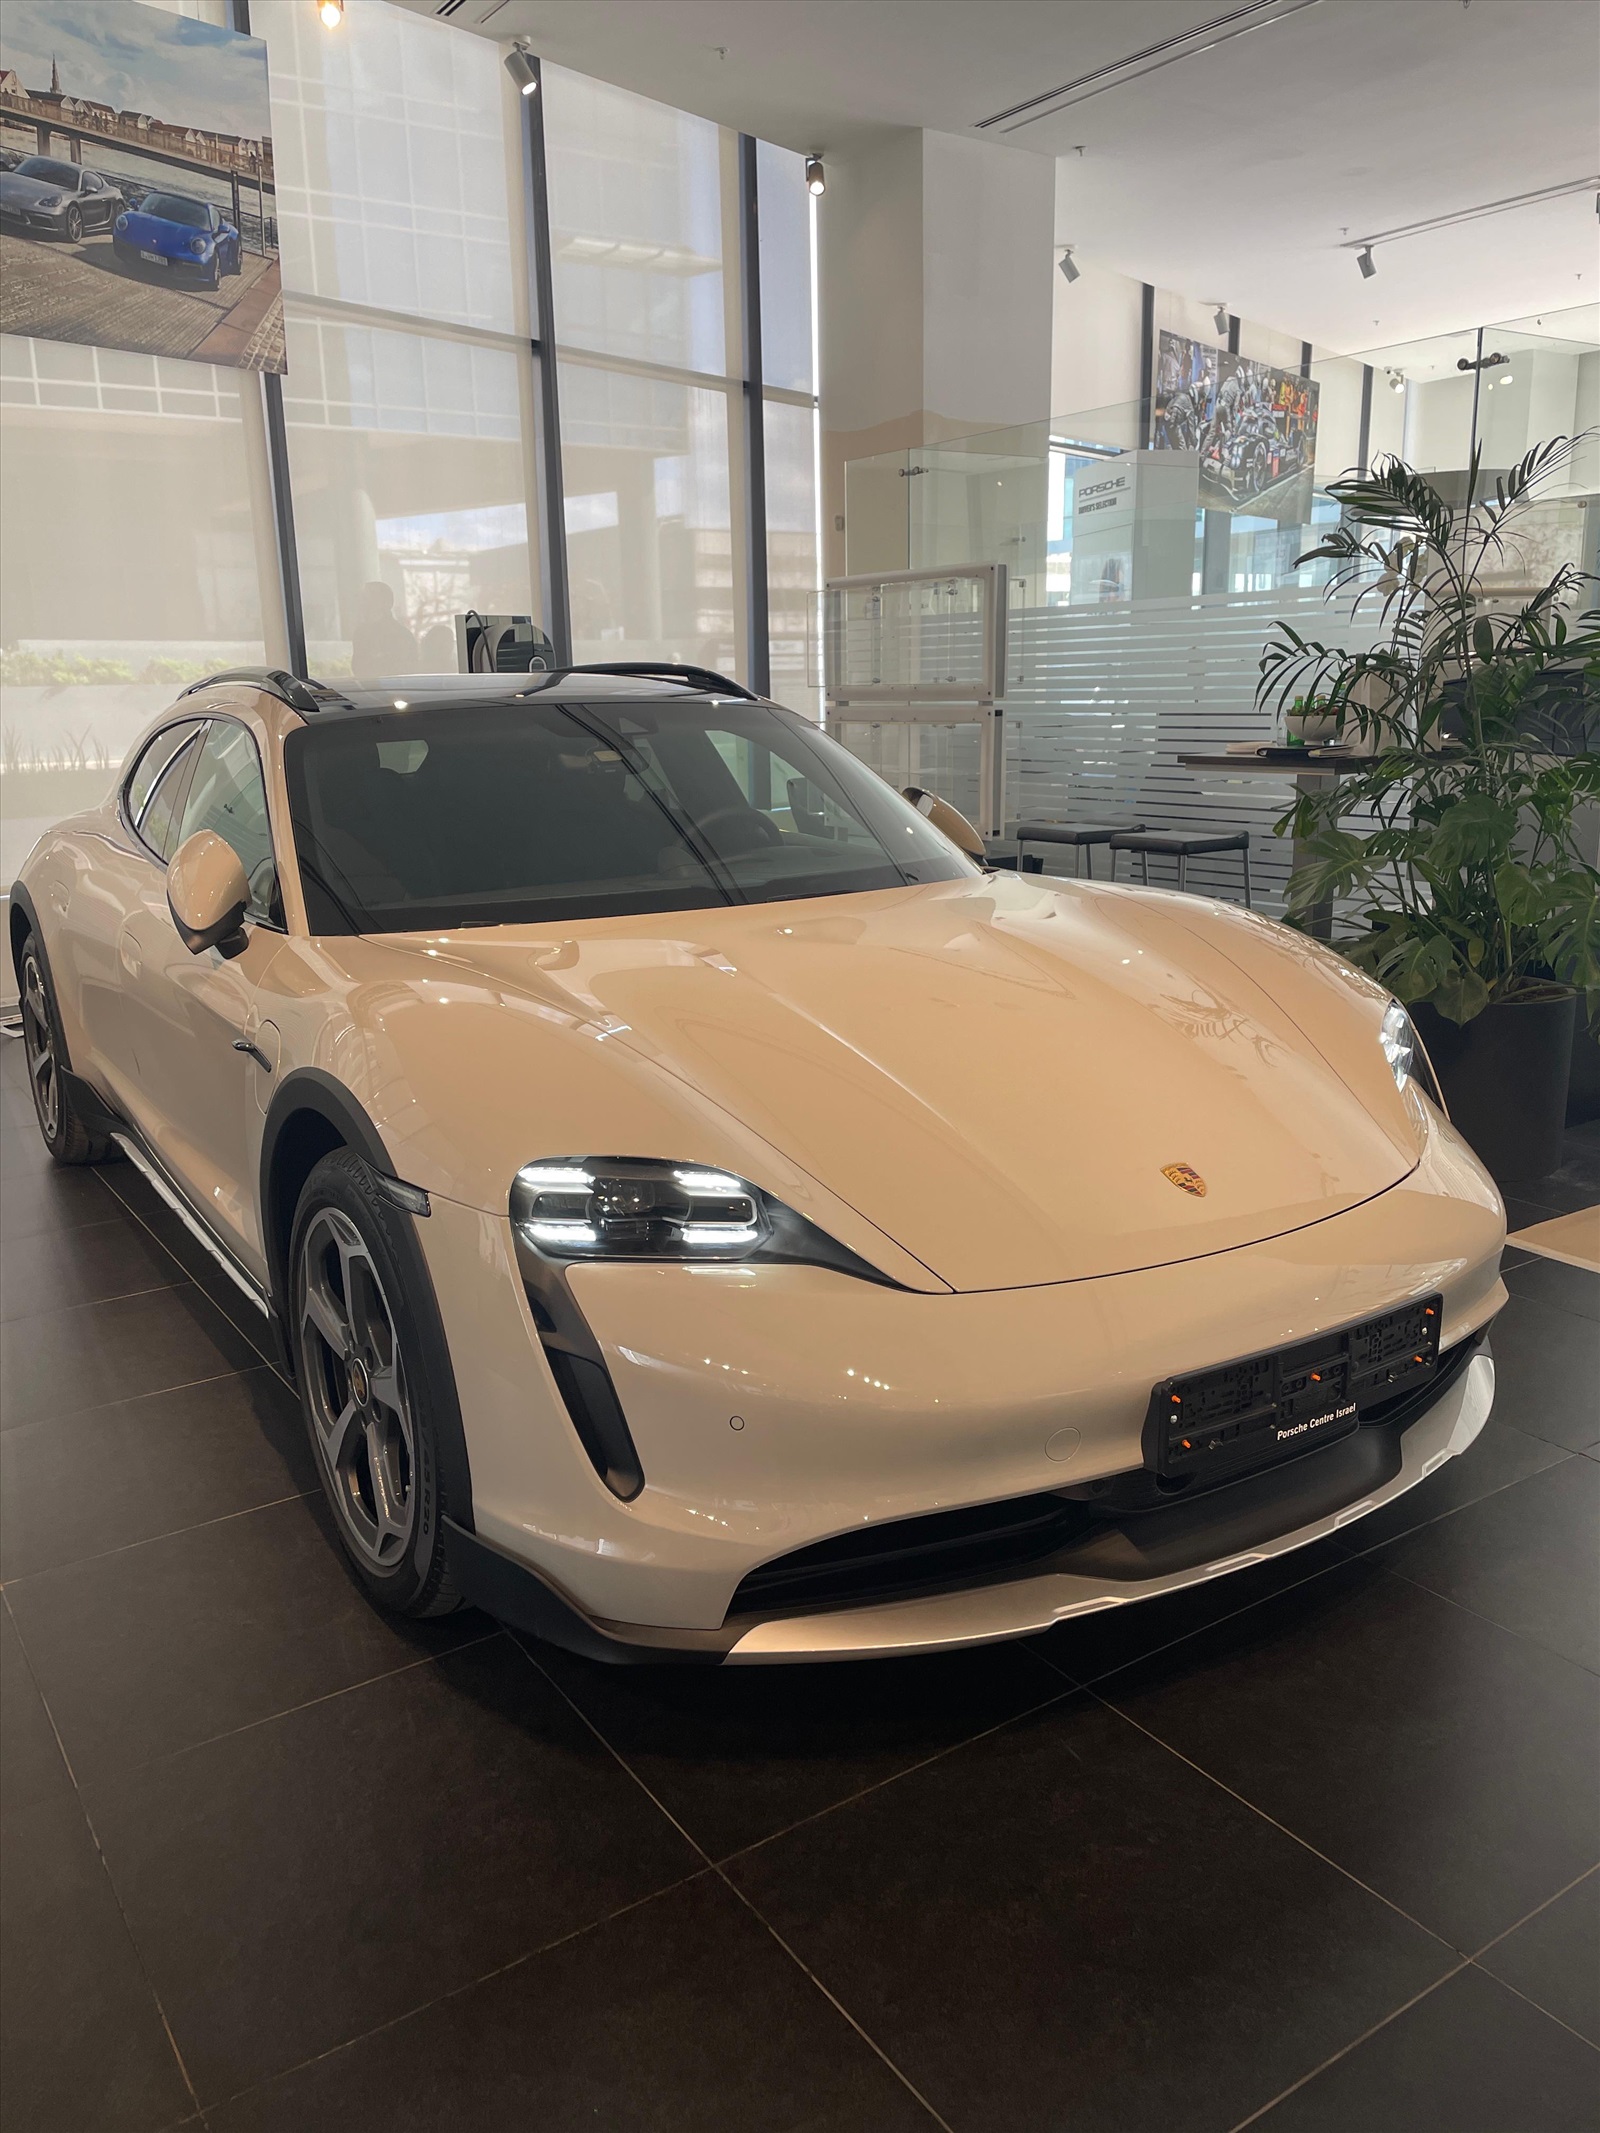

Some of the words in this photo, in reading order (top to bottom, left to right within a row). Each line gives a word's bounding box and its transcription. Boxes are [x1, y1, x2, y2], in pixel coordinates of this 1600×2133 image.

[1079, 477, 1125, 498] PORSCHE
[1277, 1424, 1308, 1441] Porsche
[1309, 1412, 1335, 1429] Centre
[1335, 1402, 1356, 1419] Israel
